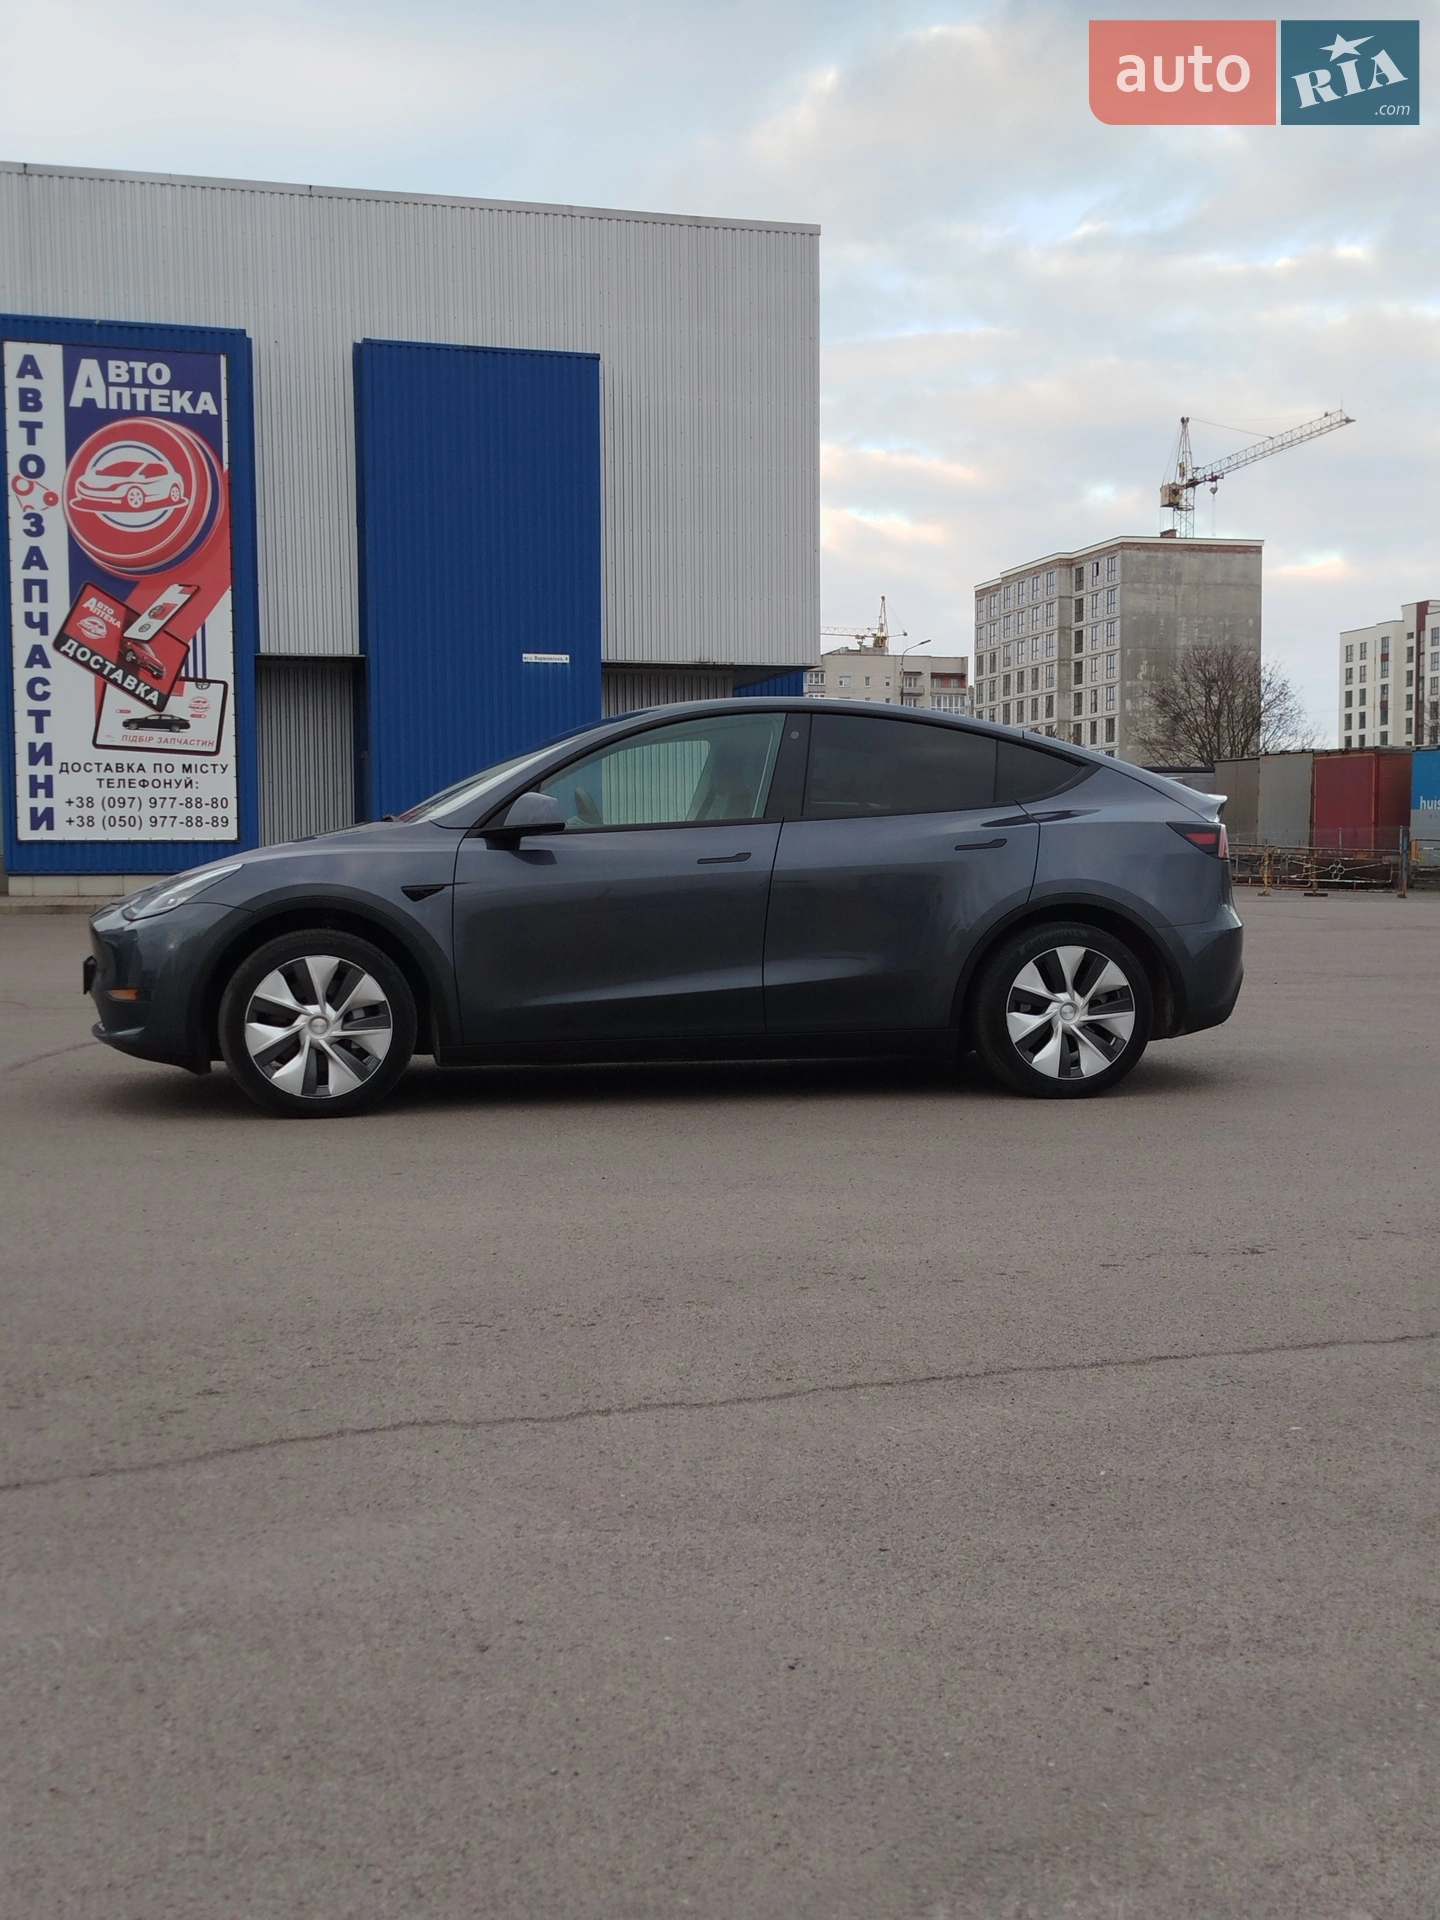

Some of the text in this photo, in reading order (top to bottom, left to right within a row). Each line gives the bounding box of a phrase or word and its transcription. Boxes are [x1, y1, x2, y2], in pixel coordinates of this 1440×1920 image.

[59, 638, 160, 706] ДОСТАВКА
[121, 734, 154, 744] ПІДБІР
[157, 736, 215, 748] ЗАПЧАСТИН
[58, 761, 229, 775] ДОСТАВКА ПО МІСТУ
[96, 776, 200, 790] ТЕЛЕФОНУЙ:
[65, 796, 229, 812] +38 (097) 977-88-80
[65, 815, 229, 831] +38 (050) 977-88-89
